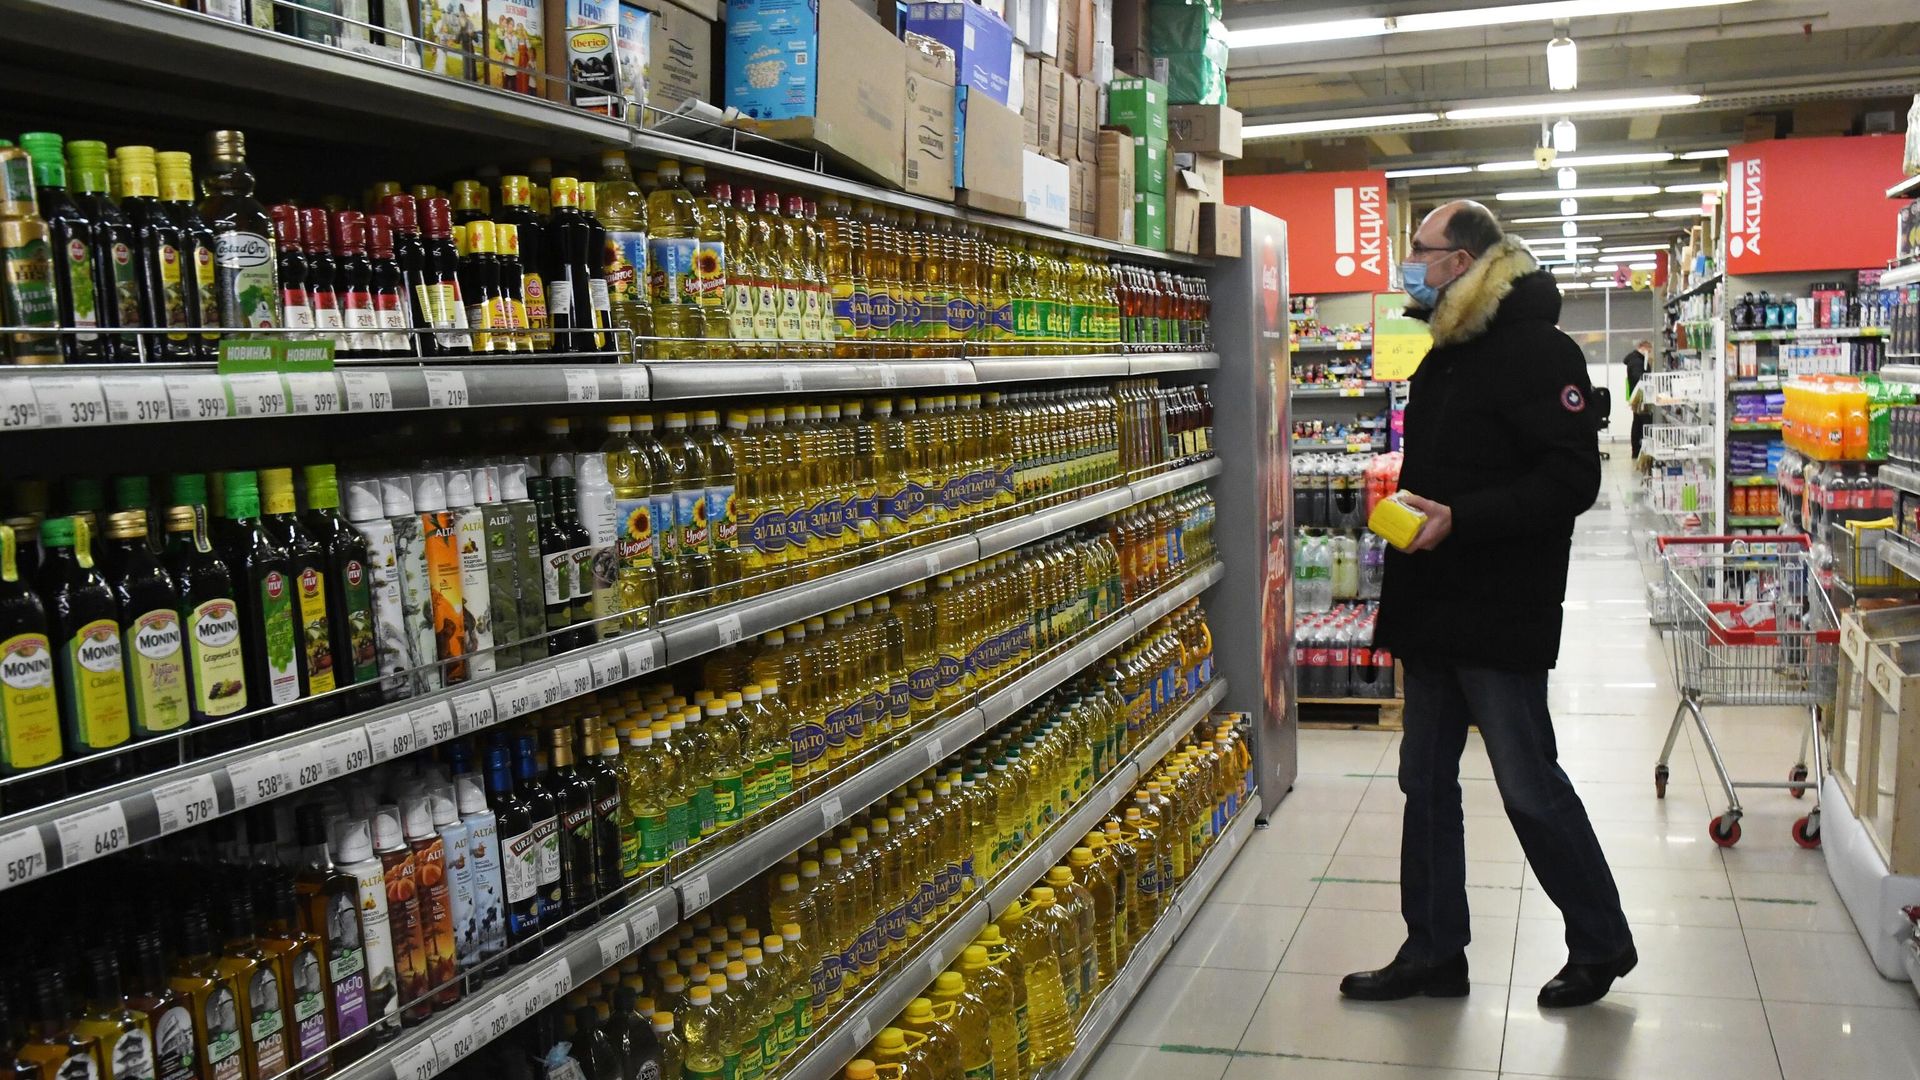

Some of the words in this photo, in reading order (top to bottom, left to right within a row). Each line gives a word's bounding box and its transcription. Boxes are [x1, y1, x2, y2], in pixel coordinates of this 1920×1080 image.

[573, 38, 606, 48] Iberica
[1746, 158, 1763, 256] АКЦИЯ
[1359, 186, 1384, 275] АКЦИЯ
[227, 346, 272, 361] НОВИНКА
[287, 347, 328, 362] НОВИНКА
[259, 394, 278, 413] 399
[314, 393, 332, 411] 399
[369, 392, 385, 409] 187
[448, 390, 463, 406] 219
[70, 402, 95, 423] 339
[137, 400, 159, 420] 319
[198, 398, 219, 417] 399
[199, 619, 238, 637] MONINI
[139, 631, 180, 649] MONINI
[607, 666, 619, 682] 209
[574, 677, 586, 693] 398
[512, 697, 525, 715] 549
[469, 709, 489, 728] 1149
[432, 722, 448, 742] 539
[393, 734, 409, 754] 689
[346, 750, 363, 771] 639
[300, 764, 318, 785] 628
[258, 775, 279, 798] 538
[186, 800, 208, 824] 578
[95, 829, 118, 854] 648
[7, 855, 34, 883] 587
[555, 981, 567, 997] 216
[525, 1002, 537, 1016] 649
[491, 1020, 505, 1037] 283
[454, 1042, 470, 1058] 824
[416, 1063, 432, 1080] 219
